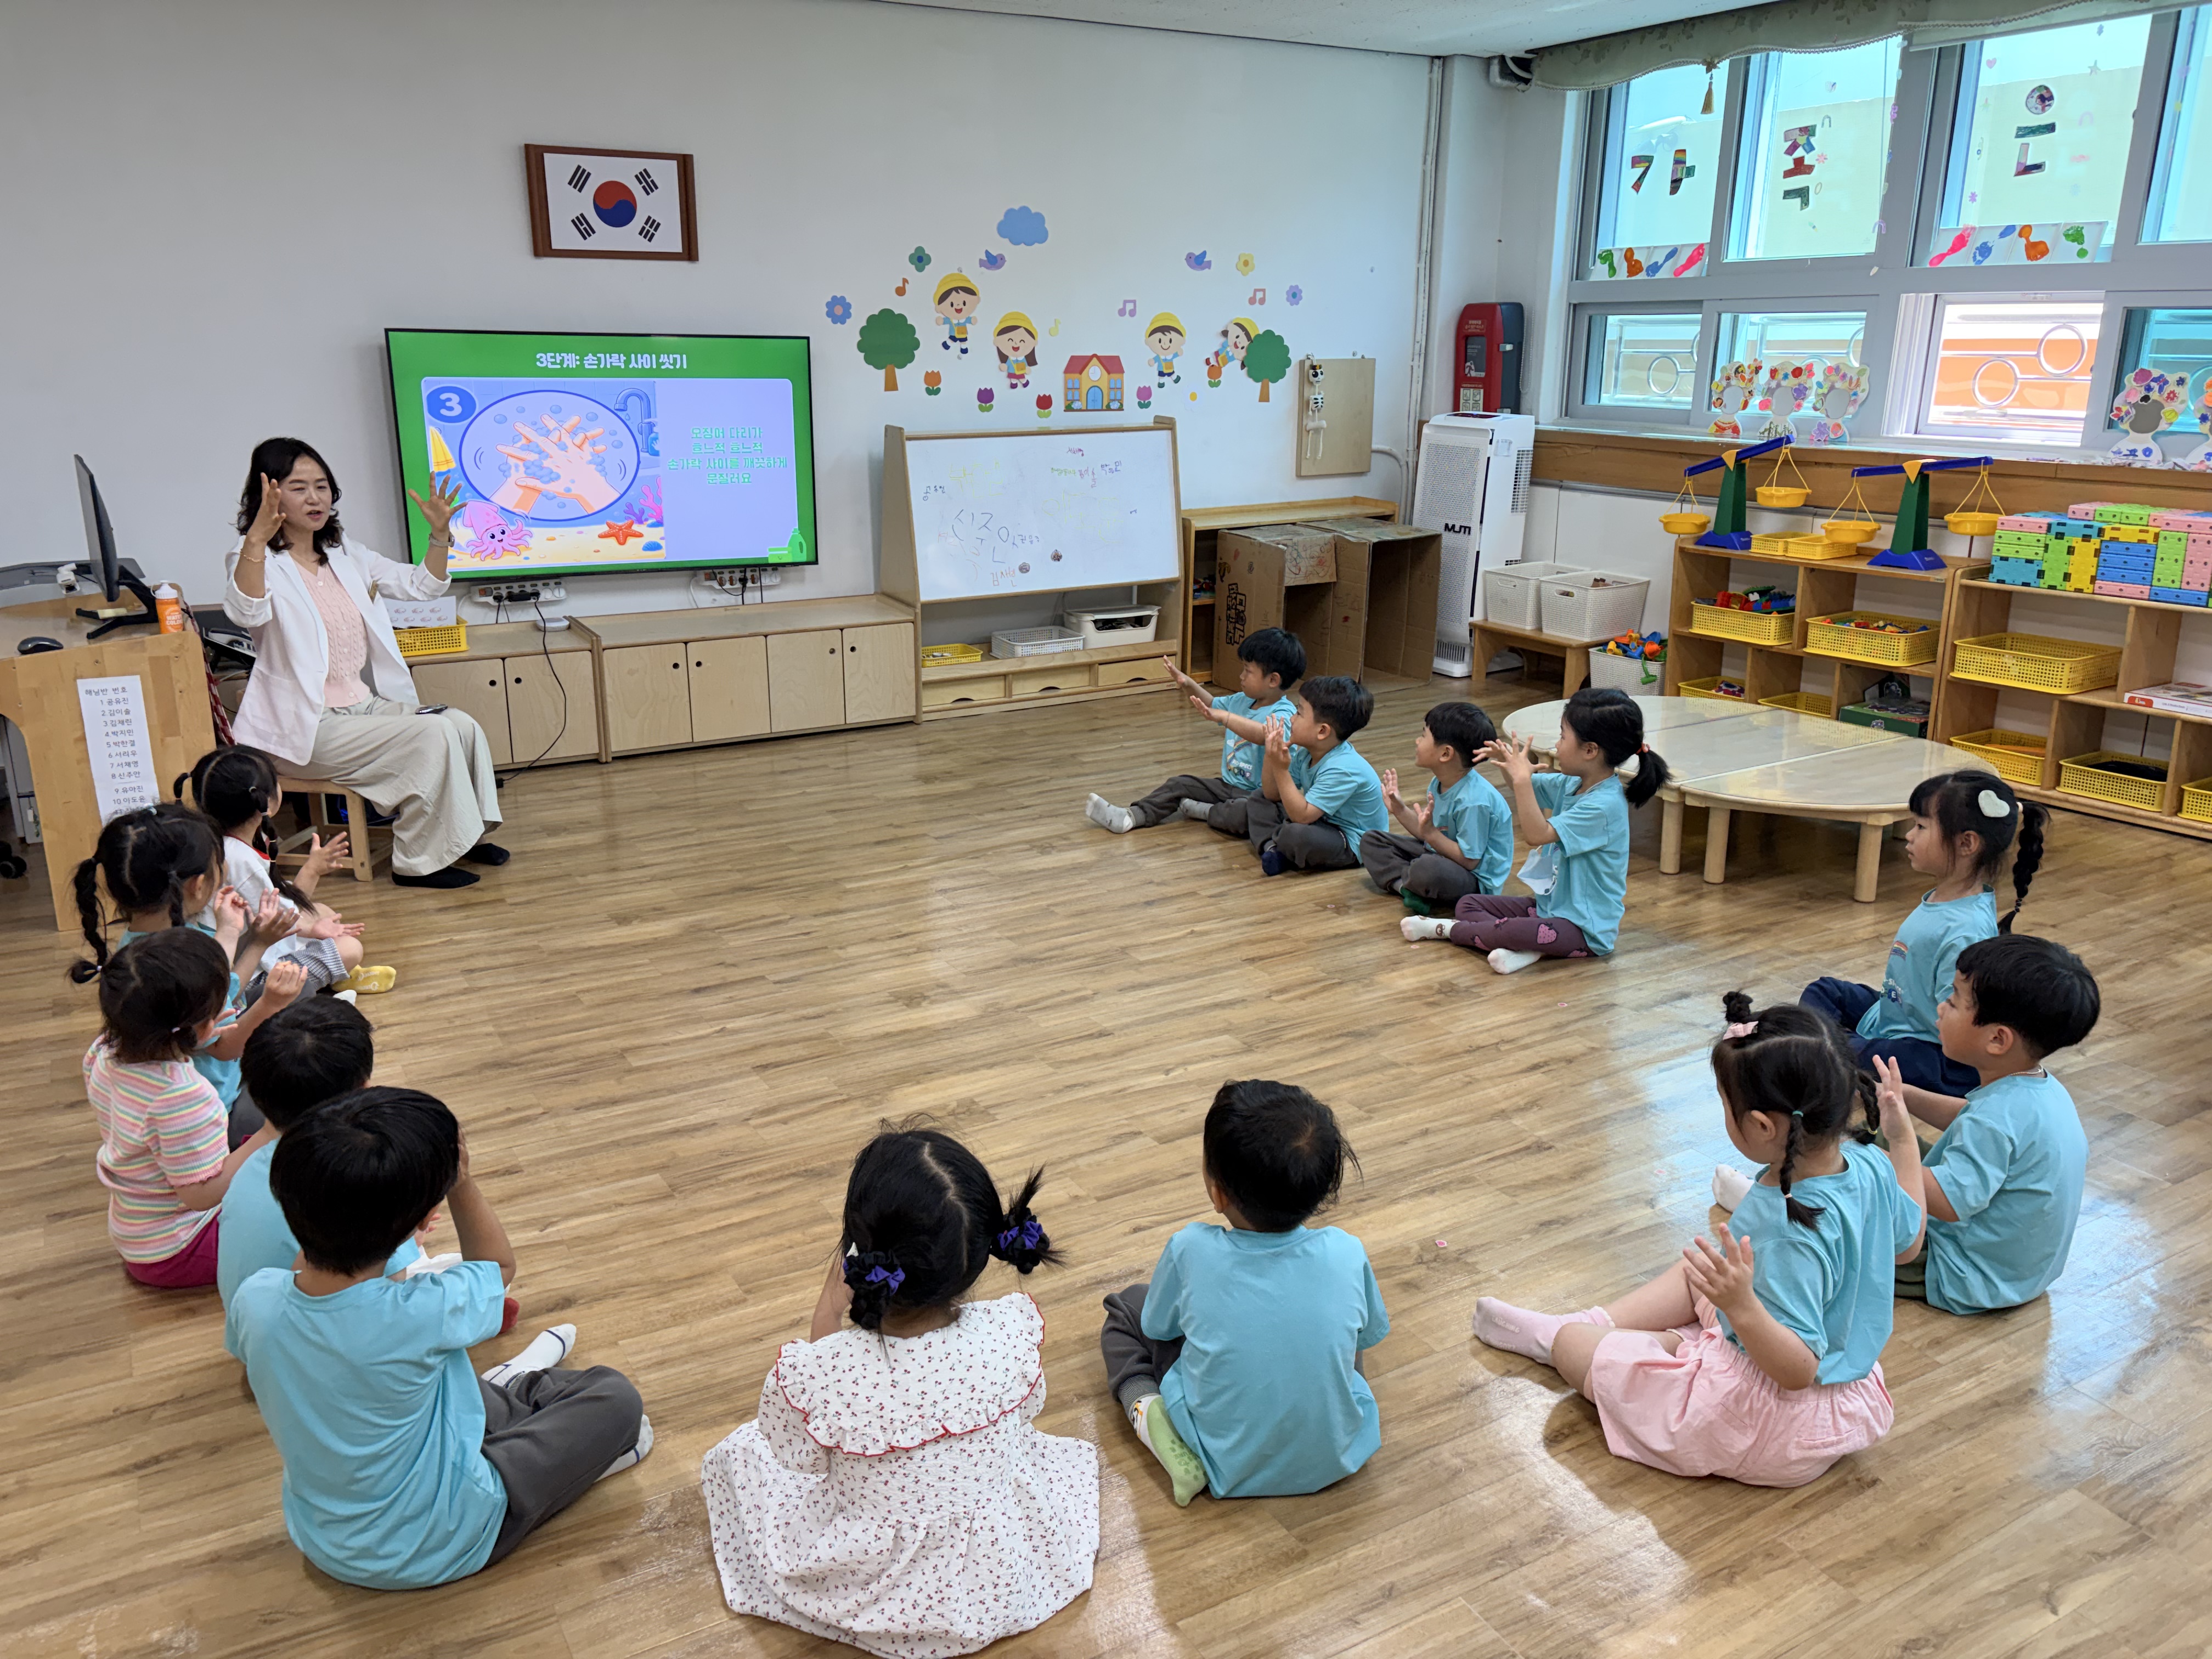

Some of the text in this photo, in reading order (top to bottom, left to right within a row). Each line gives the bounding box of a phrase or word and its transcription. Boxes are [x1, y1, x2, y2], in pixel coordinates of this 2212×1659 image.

[536, 353, 687, 369] 3단계: 손가락 사이 씻기
[439, 392, 462, 417] 3
[691, 427, 763, 439] 오징어 다리가
[692, 442, 763, 454] 흐느적 흐느적
[667, 456, 788, 470] 손가락 사이를 깨끗하게
[706, 472, 752, 485] 문질러요
[85, 686, 128, 696] 해님반 번호
